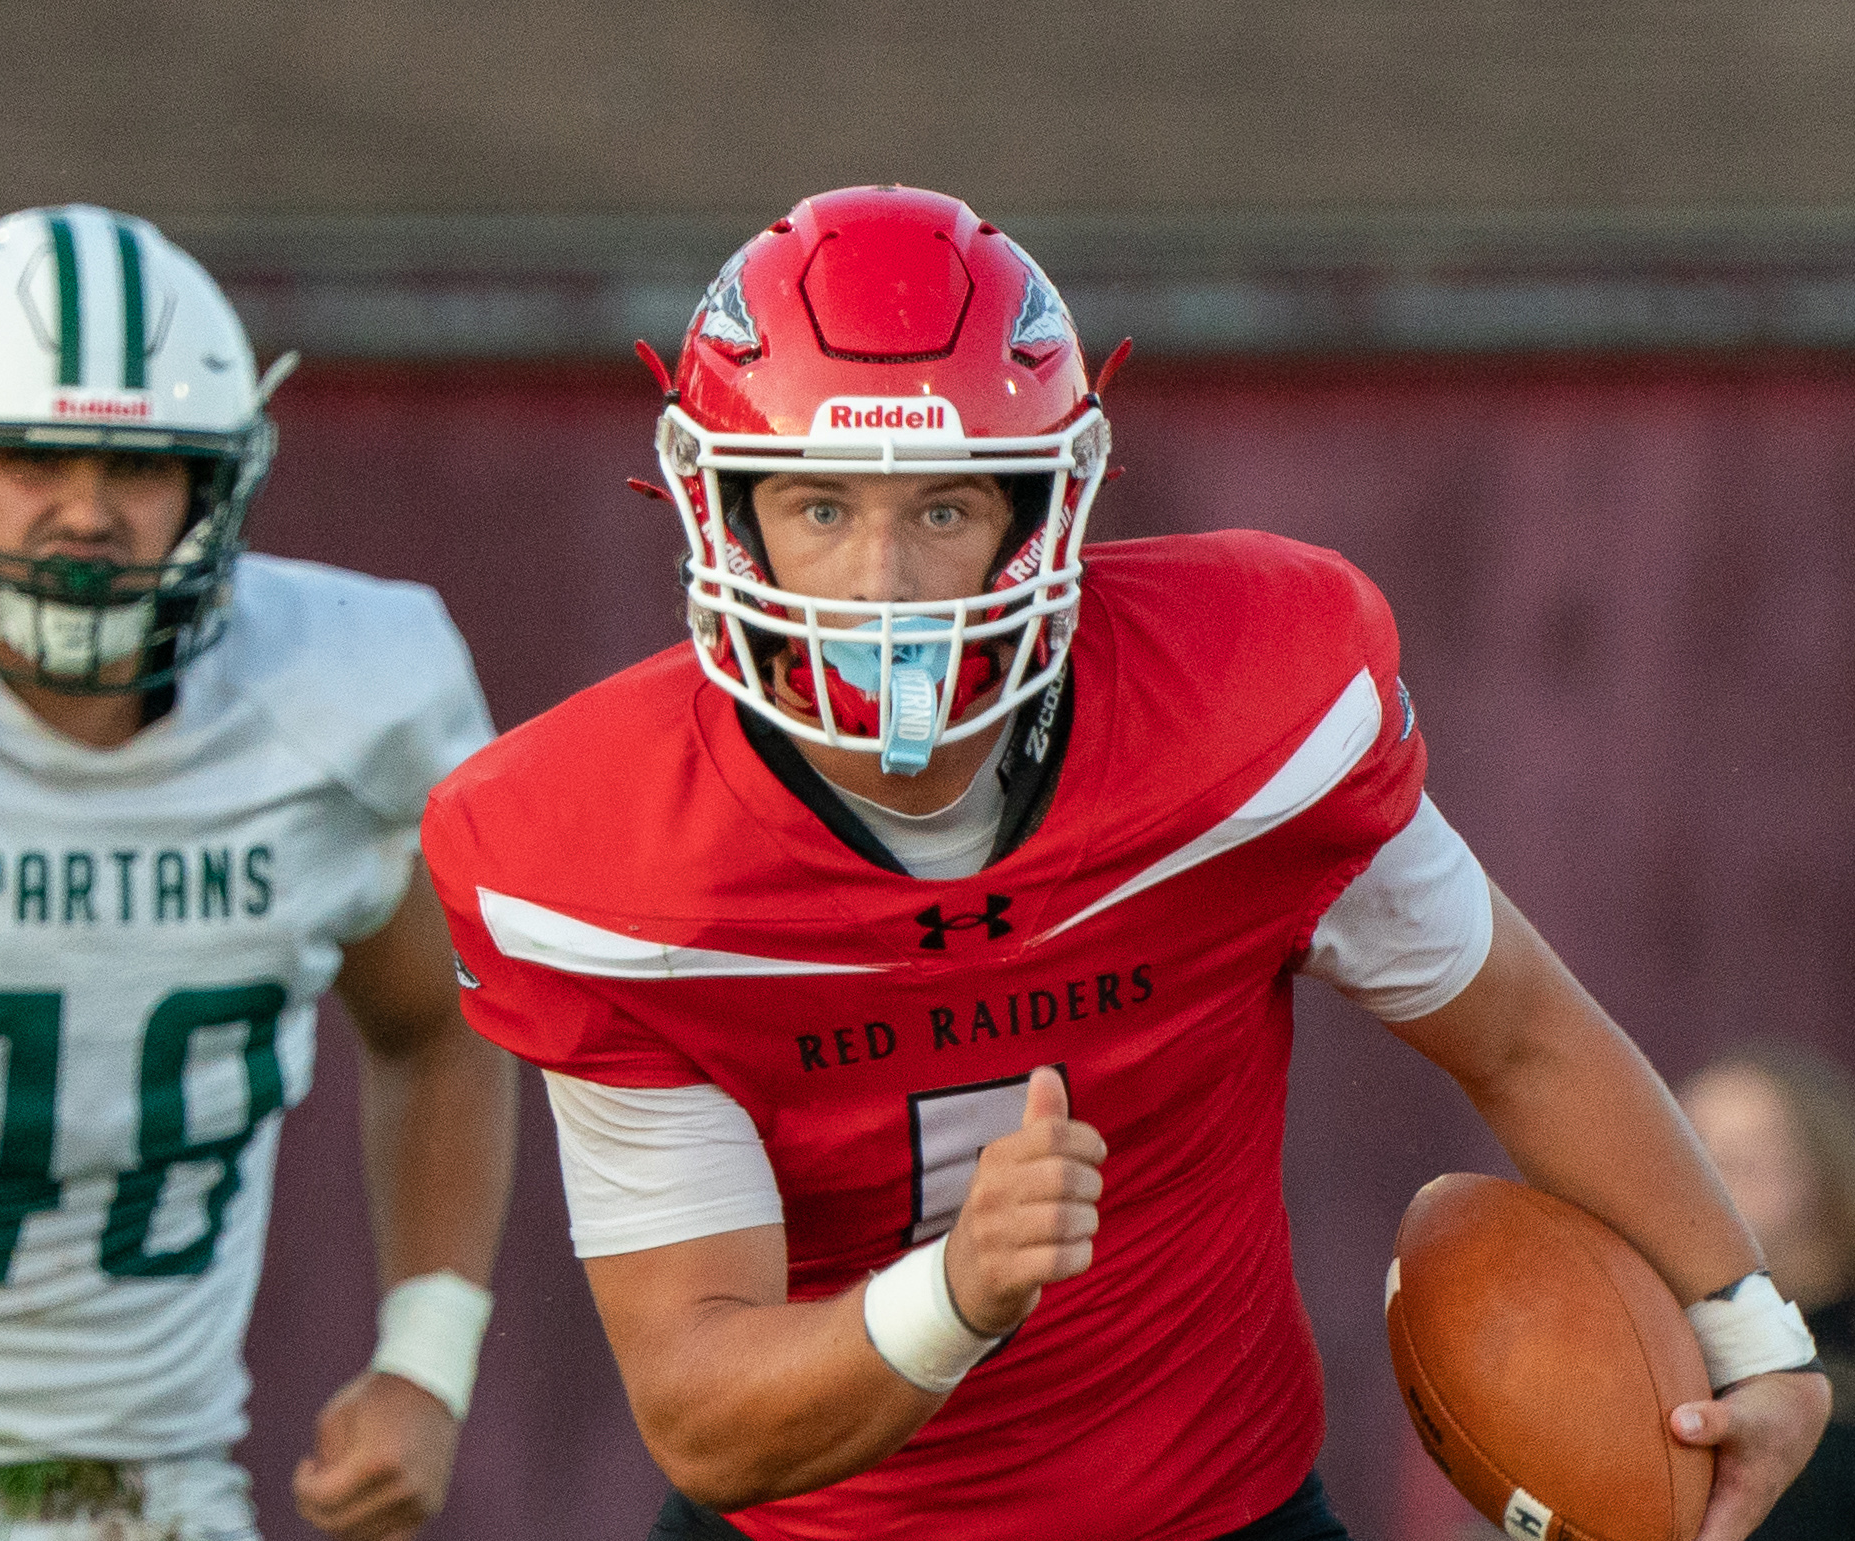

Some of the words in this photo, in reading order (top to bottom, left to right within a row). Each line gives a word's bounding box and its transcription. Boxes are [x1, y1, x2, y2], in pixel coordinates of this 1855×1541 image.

[830, 405, 944, 429] Riddell
[795, 1021, 897, 1072] RED
[929, 963, 1155, 1050] RAIDERS
